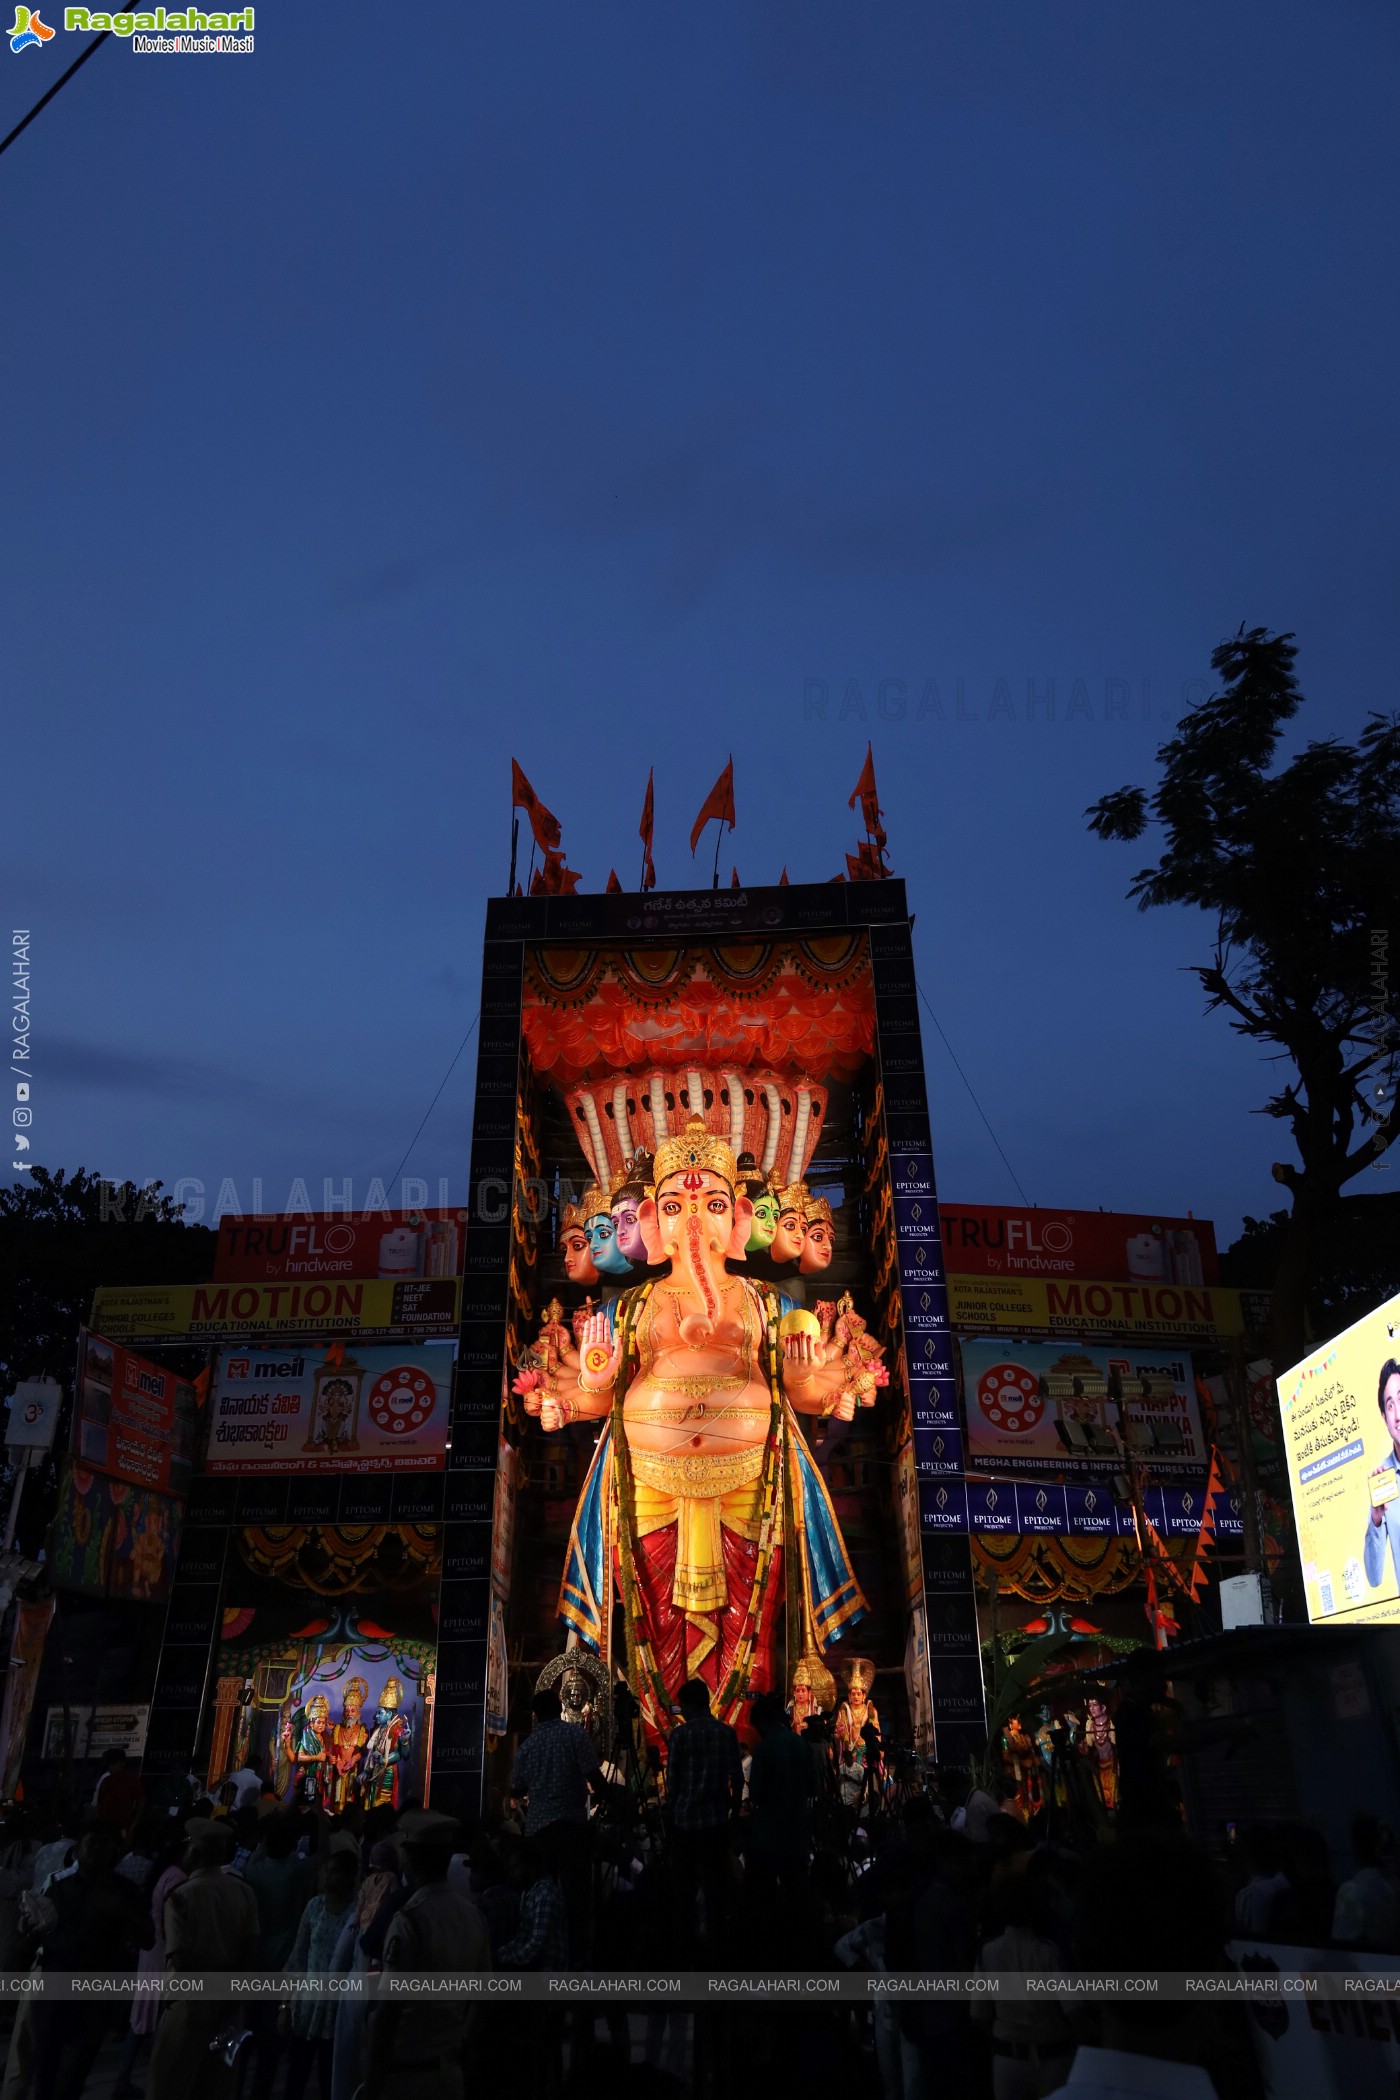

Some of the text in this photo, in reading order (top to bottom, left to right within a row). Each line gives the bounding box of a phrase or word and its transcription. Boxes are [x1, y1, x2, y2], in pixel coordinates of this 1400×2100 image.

[941, 1216, 1073, 1252] TRUFLO
[225, 1224, 356, 1256] TRUFLO
[266, 1257, 353, 1276] by hindware
[987, 1253, 1076, 1271] by hindware
[904, 1269, 940, 1277] EPITOME
[974, 1287, 1023, 1296] RAJASTHAN'S
[191, 1284, 364, 1320] MOTION
[403, 1293, 424, 1302] NEET
[1046, 1283, 1214, 1322] MOTION
[402, 1303, 418, 1312] SAT
[956, 1301, 1033, 1312] JUNIOR COLLEGES
[133, 1312, 176, 1322] COLLEGES
[401, 1312, 451, 1322] FOUNDATION
[908, 1315, 944, 1323] EPITOME
[956, 1311, 996, 1321] SCHOOLS
[189, 1317, 361, 1332] EDUCATIONAL INSTITUTIONS
[1049, 1316, 1217, 1333] EDUCATIONAL INSTITUTIONS
[254, 1357, 306, 1378] meil
[912, 1362, 949, 1370] EPITOME
[220, 1393, 300, 1415] వినాయక చవితి
[916, 1411, 954, 1420] EPITOME
[216, 1420, 288, 1450] శుభాకాంక్షలు
[307, 1460, 317, 1469] &
[920, 1461, 959, 1470] EPITOME
[974, 1458, 1011, 1467] MEGHA
[1013, 1459, 1079, 1470] ENGINEERING
[1081, 1461, 1089, 1470] &
[924, 1514, 961, 1523] EPITOME
[974, 1515, 1012, 1524] EPITOME
[1024, 1516, 1062, 1525] EPITOME
[1073, 1517, 1111, 1526] EPITOME
[1171, 1518, 1203, 1527] EPITOM
[928, 1570, 967, 1579] EPITOME
